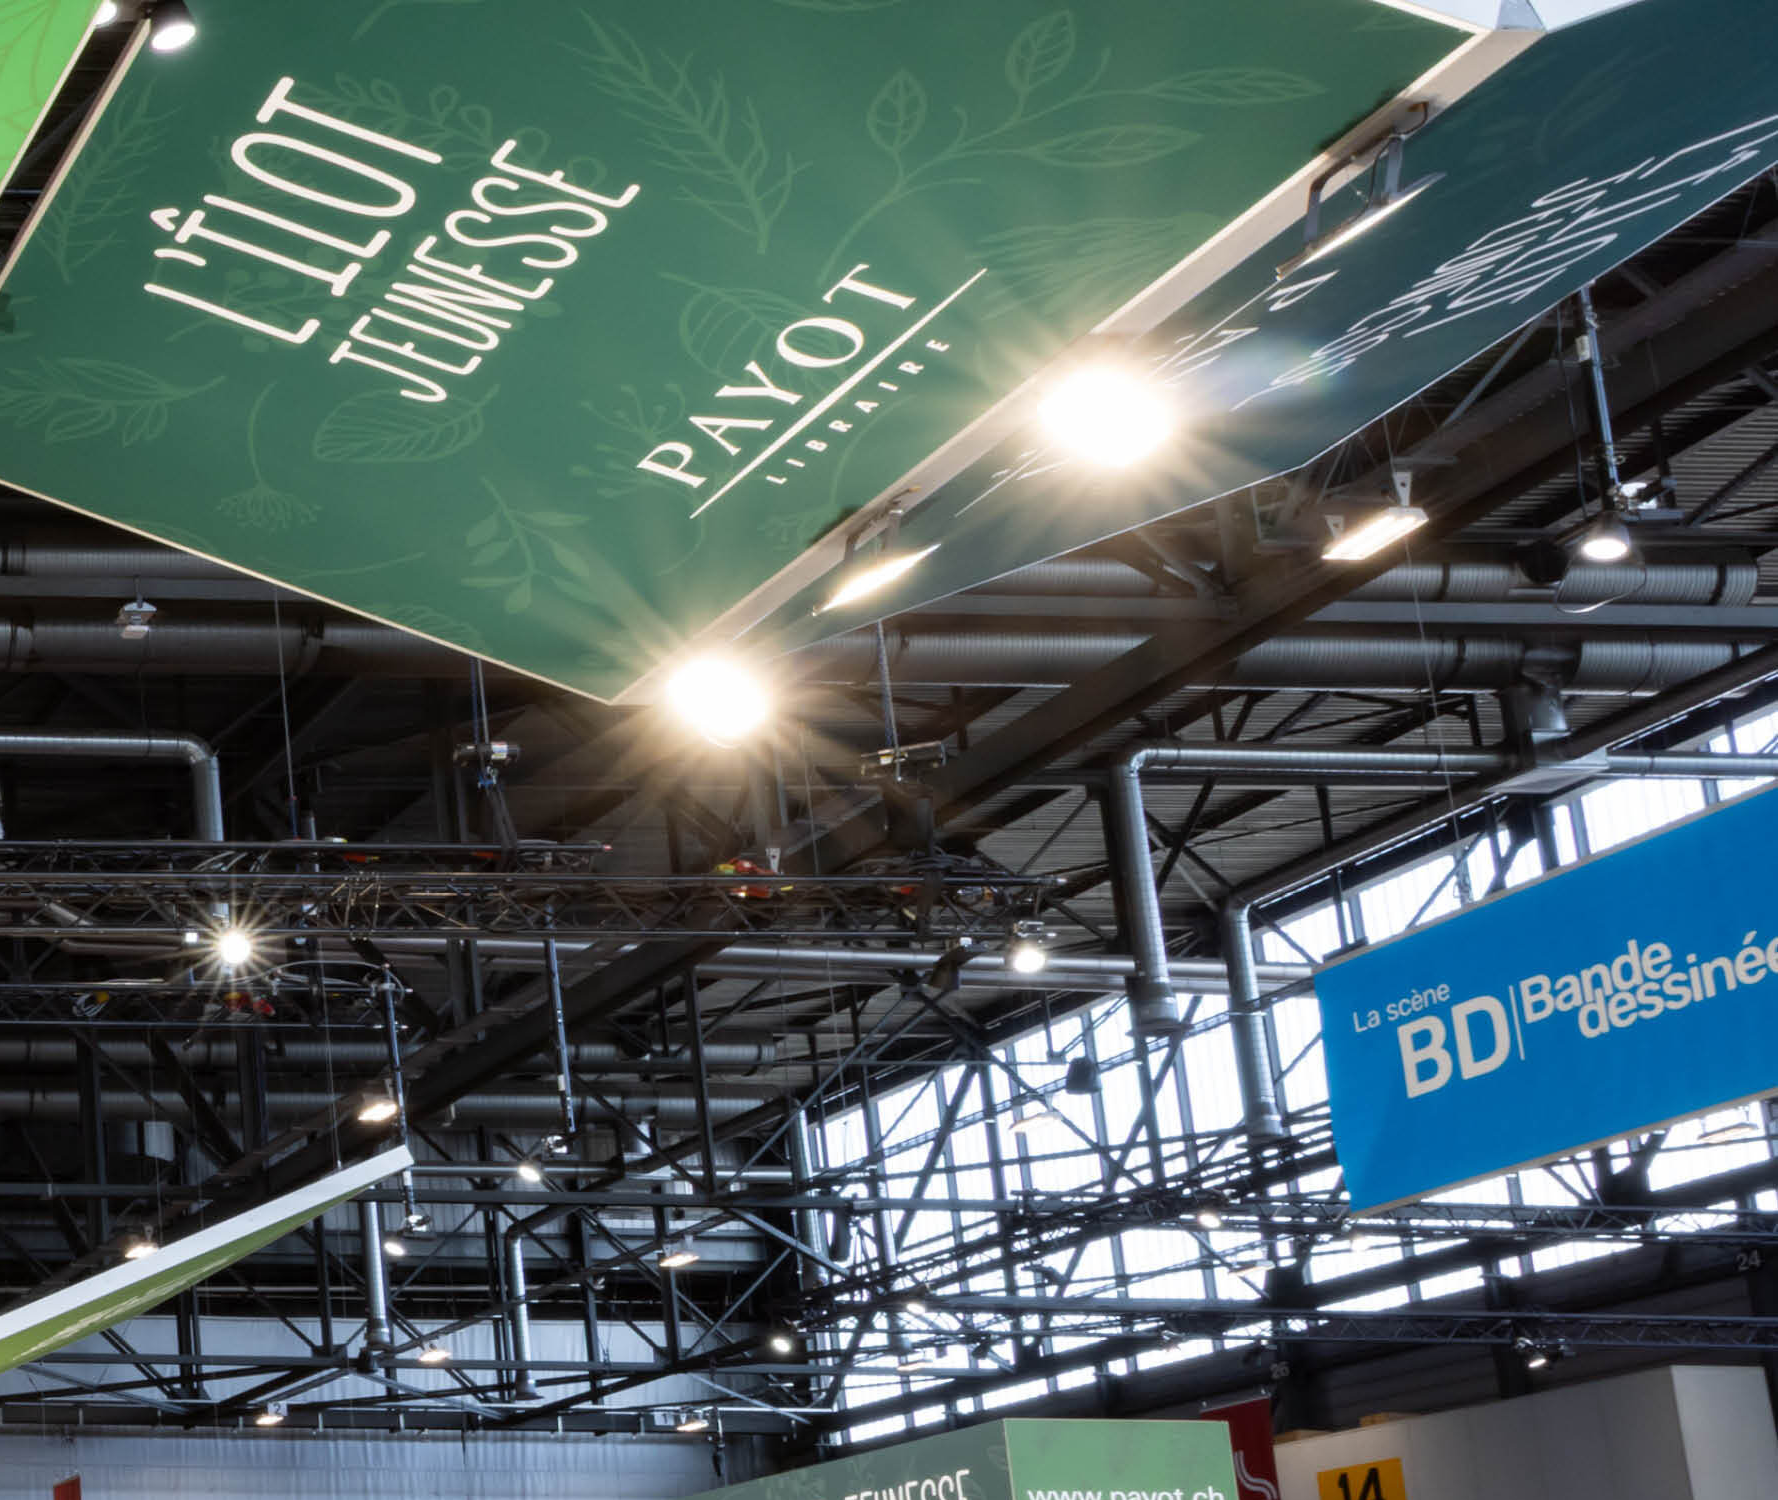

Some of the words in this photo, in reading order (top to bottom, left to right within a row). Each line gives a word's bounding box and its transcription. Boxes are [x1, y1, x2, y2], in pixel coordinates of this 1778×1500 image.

[144, 75, 445, 346] L'ÎLOT
[328, 139, 641, 403] JEUNESSE
[636, 261, 927, 491] PAYOT
[765, 337, 952, 485] LIBRAIRE
[1352, 1005, 1381, 1033] La
[1386, 981, 1450, 1019] scène
[1397, 995, 1511, 1099] BD
[1519, 939, 1672, 1024] Bande
